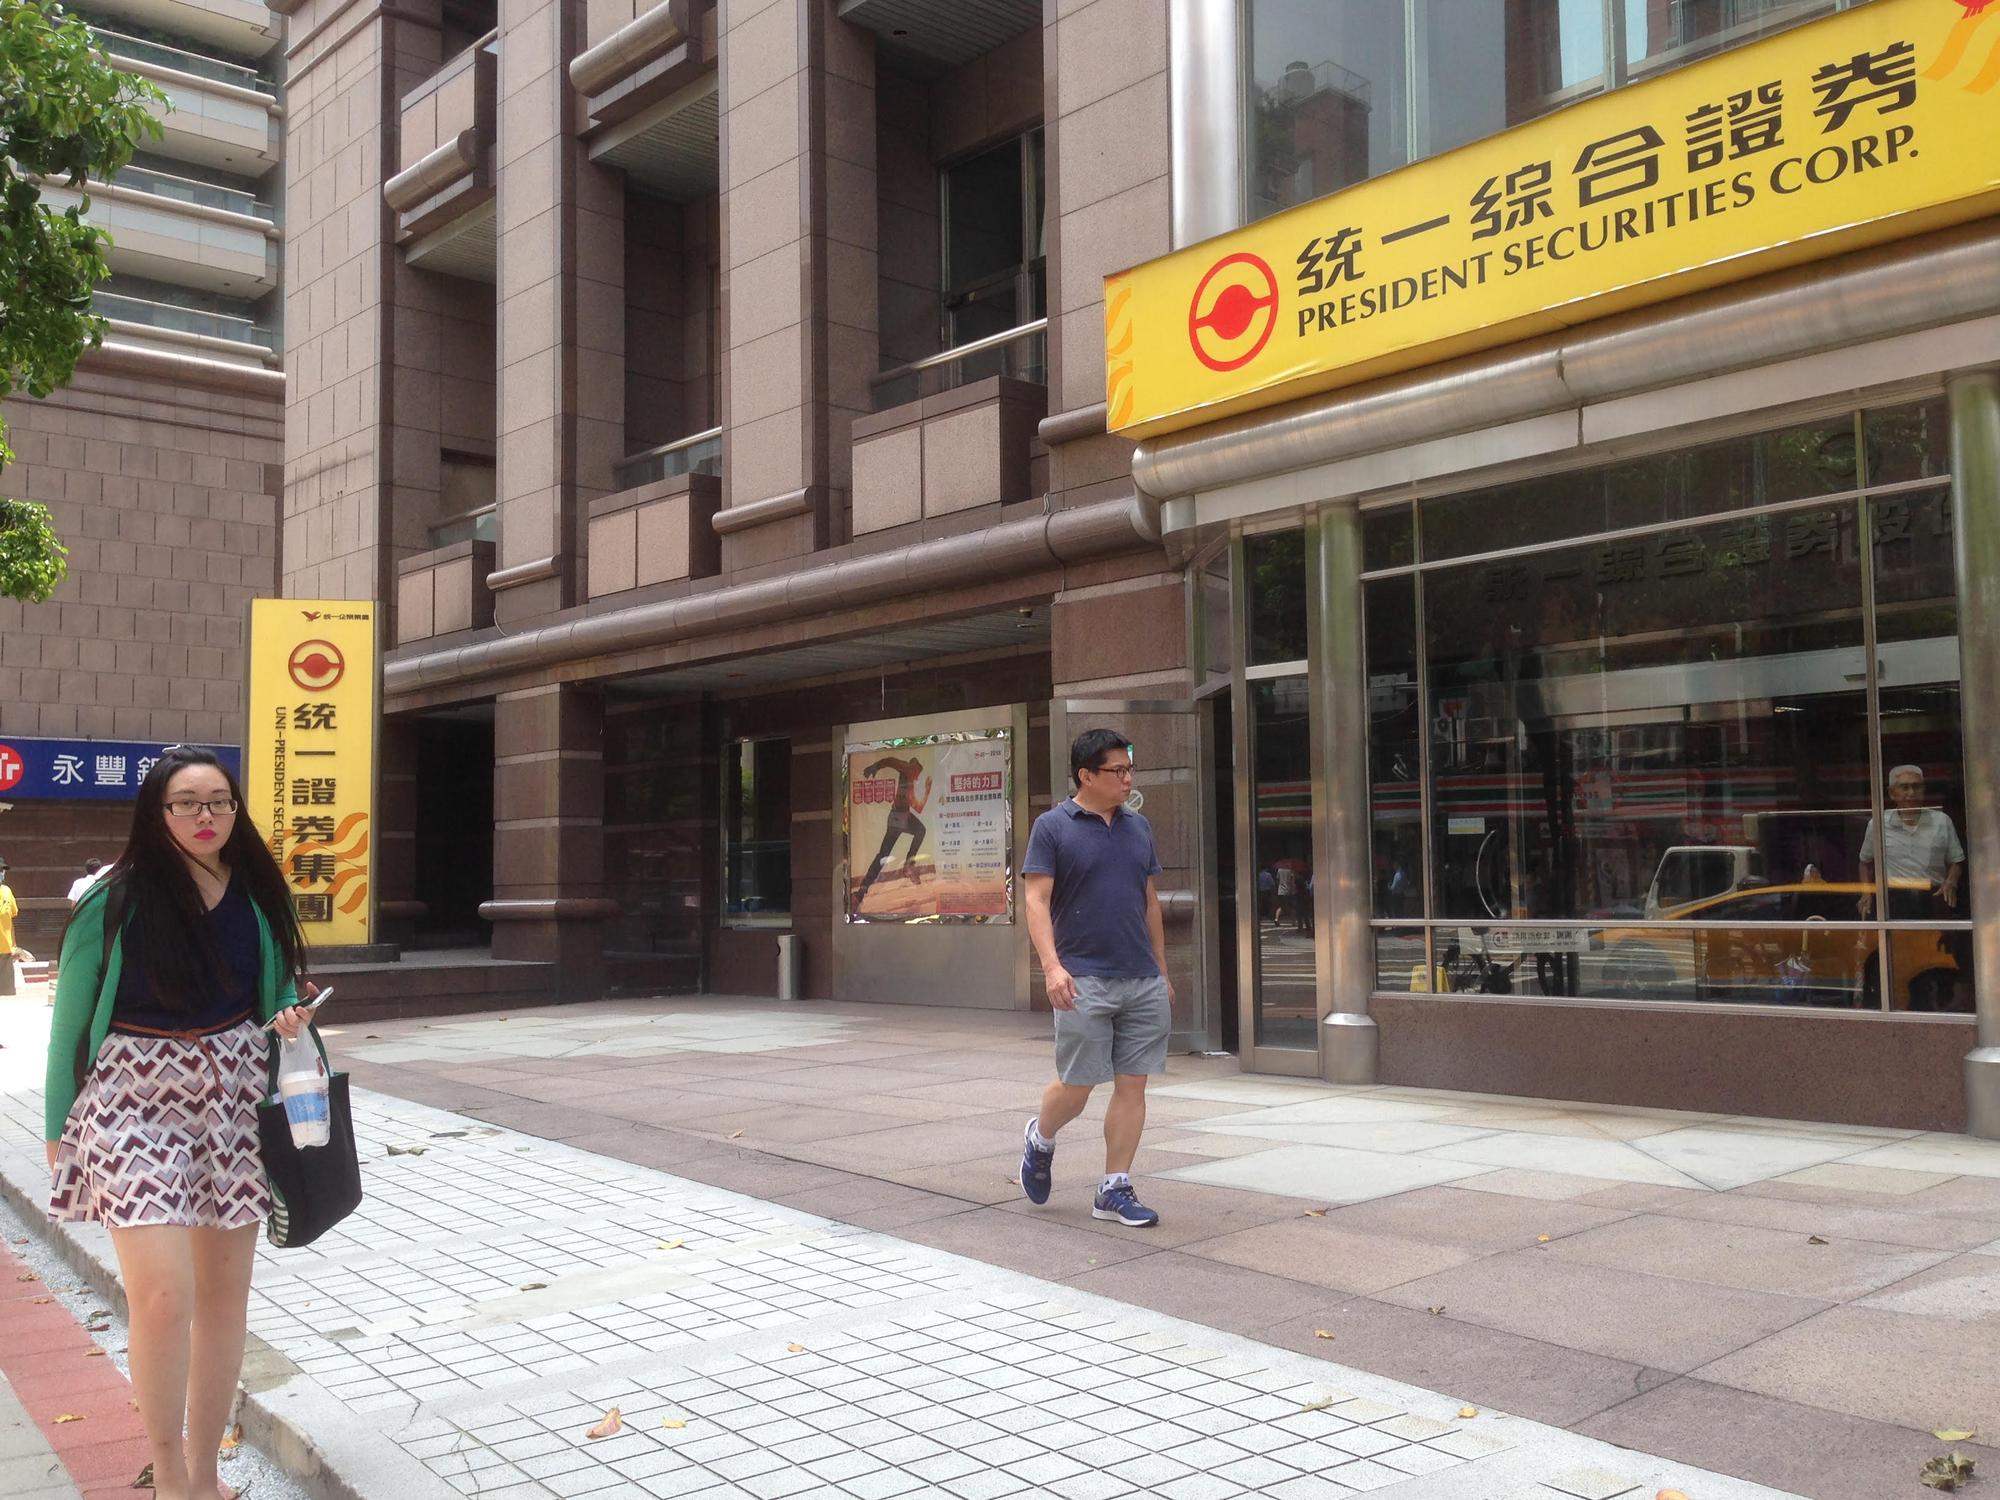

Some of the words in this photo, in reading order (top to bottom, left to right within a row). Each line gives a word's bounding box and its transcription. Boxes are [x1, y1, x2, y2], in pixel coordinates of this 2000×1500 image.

[1296, 41, 1917, 296] 統一綜合證券
[1297, 250, 1492, 338] PRESIDENT
[1503, 173, 1755, 277] SECURITIES
[1769, 125, 1918, 195] CORP.
[274, 707, 287, 805] UNI-PRESIDENT
[291, 703, 337, 922] 統一證券集團
